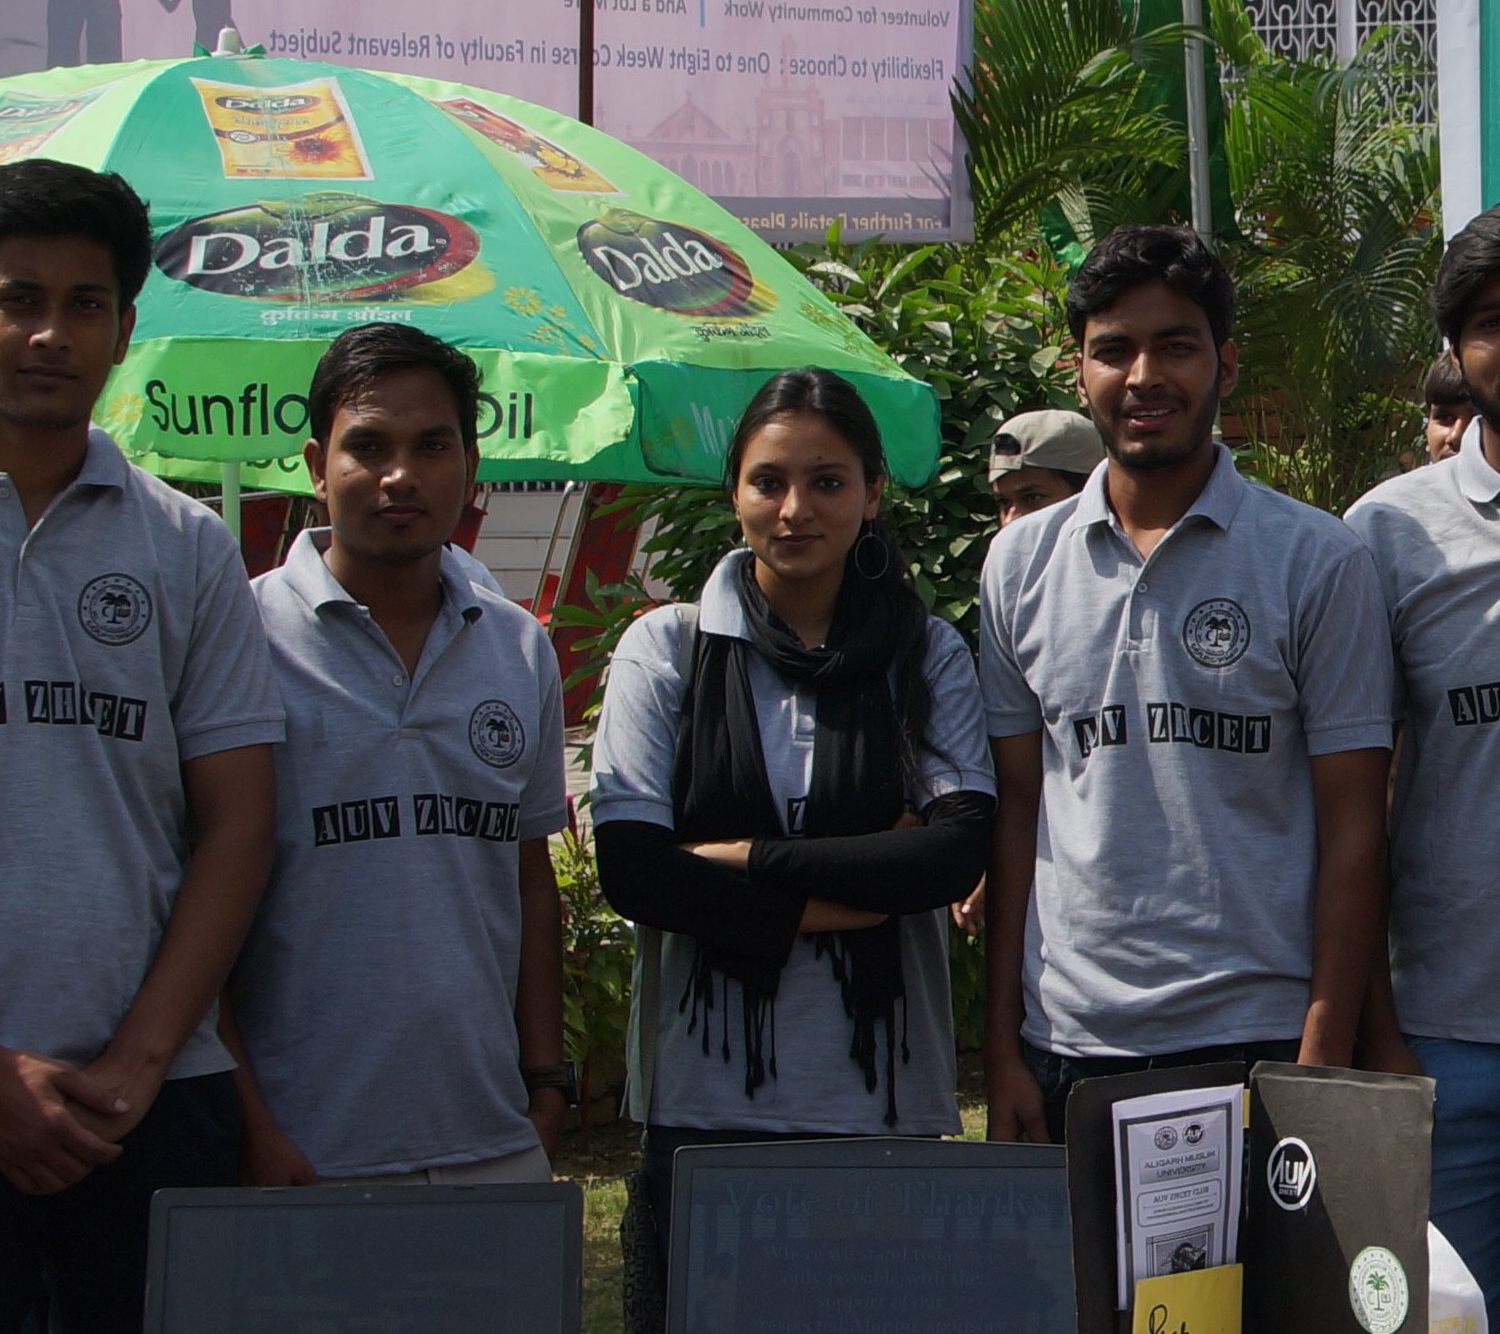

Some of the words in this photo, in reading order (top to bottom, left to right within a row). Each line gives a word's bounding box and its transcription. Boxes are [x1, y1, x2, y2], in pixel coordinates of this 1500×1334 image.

[225, 94, 307, 111] Dalda
[187, 216, 435, 276] Dalda
[592, 232, 717, 291] Dalda
[1145, 701, 1273, 755] ZHCET
[311, 794, 400, 847] AUV
[1144, 1155, 1184, 1170] ALIGARH
[1184, 1149, 1216, 1164] MUSLIM
[723, 1180, 822, 1218] Vote
[890, 1179, 1051, 1218] Thanks
